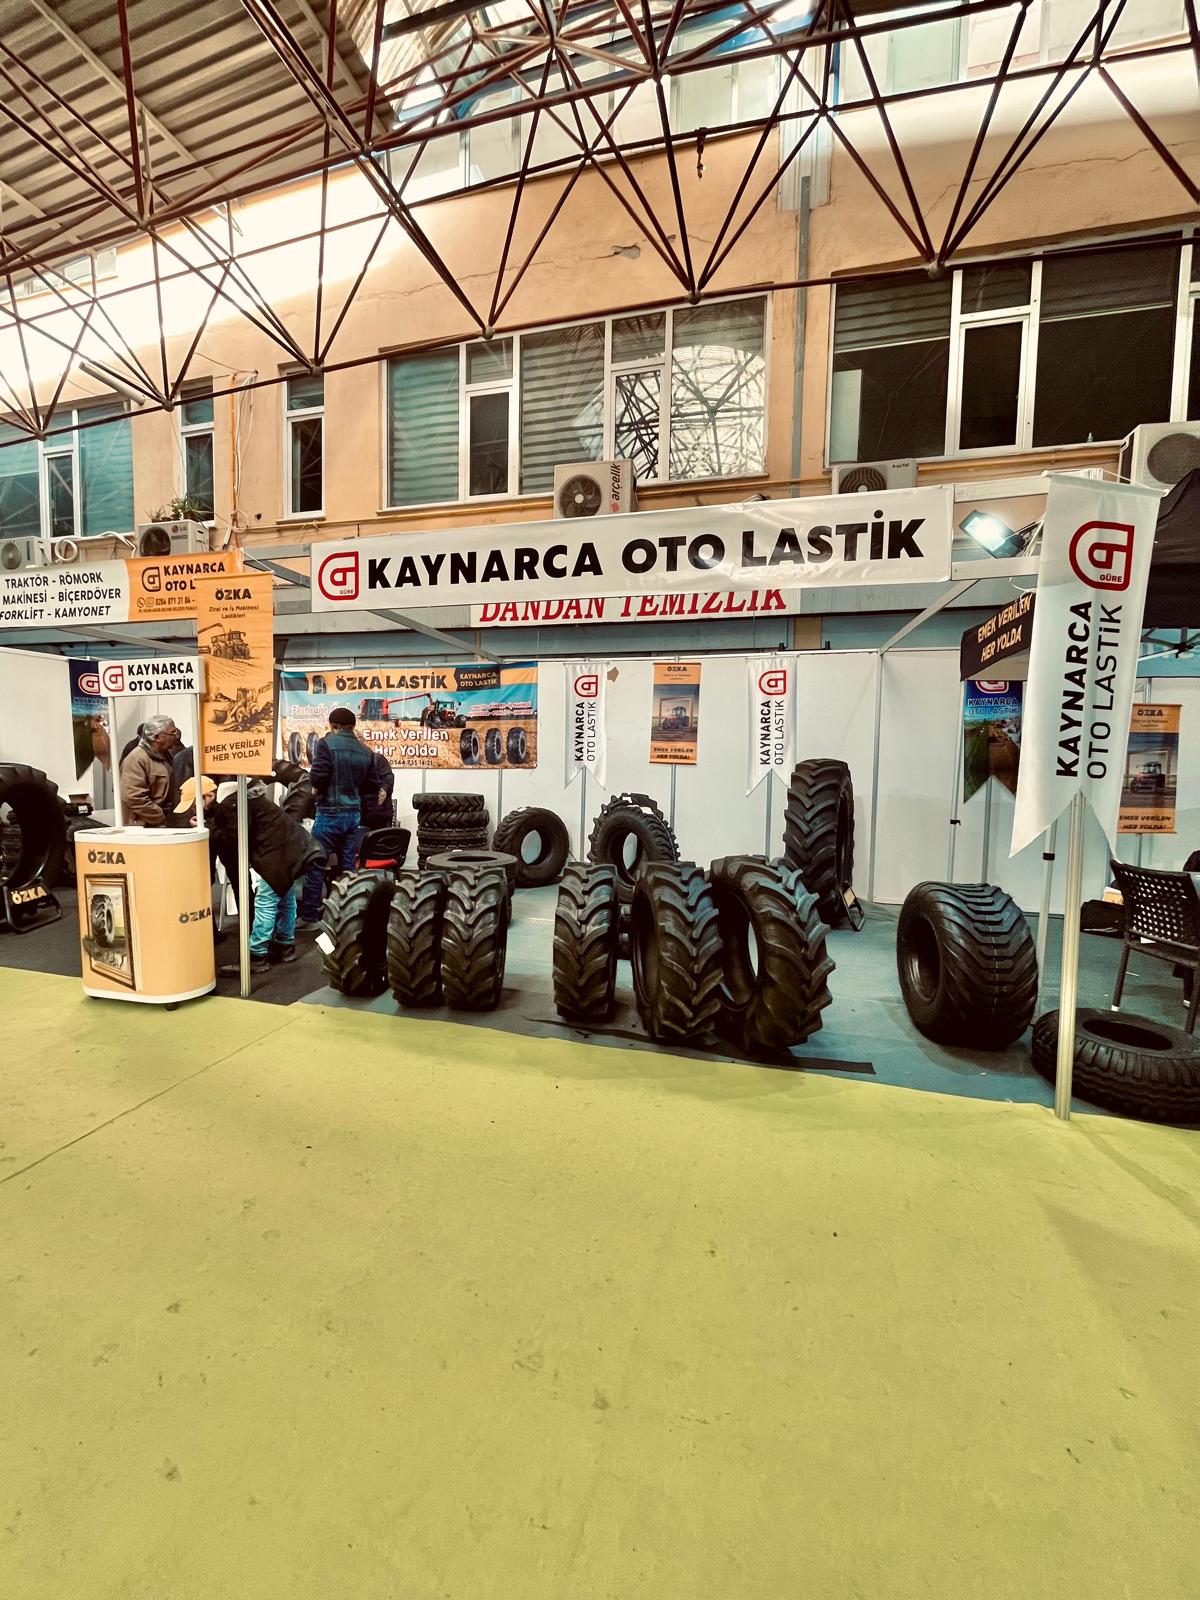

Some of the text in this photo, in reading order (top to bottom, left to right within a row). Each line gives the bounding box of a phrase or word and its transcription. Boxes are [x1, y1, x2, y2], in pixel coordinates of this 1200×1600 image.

[610, 463, 622, 501] arçelik
[367, 509, 926, 590] KAYNARCA OTO LASTİK
[163, 561, 225, 576] KAYNARCA
[5, 574, 49, 589] TRAKTÖR
[59, 571, 103, 585] RÖMORK
[164, 580, 187, 592] OTO
[1099, 574, 1123, 583] GÜRE
[2, 590, 48, 605] MAKİNESİ
[58, 587, 121, 604] BİÇERDÖVER
[215, 587, 252, 601] ÖZKA
[0, 607, 45, 620] FORKLİFT
[54, 605, 111, 618] KAMYONET
[977, 593, 1033, 644] EMEK VERİLEN
[980, 624, 1023, 662] HER YOLDA
[127, 662, 194, 676] KAYNARCA
[460, 671, 497, 679] KAYNARCA
[128, 675, 195, 692] OTO LASTİK
[335, 672, 448, 692] ÖZKA LASTİK
[1056, 601, 1092, 777] KAYNARCA
[1087, 604, 1123, 779] OTO LASTİK
[363, 726, 449, 741] Emek Verilen
[574, 701, 585, 762] KAYNARCA
[759, 699, 771, 765] KAYNARCA
[204, 739, 266, 754] EMEK VERİLEN
[400, 744, 438, 757] Yolda
[586, 741, 596, 762] OTO
[774, 743, 784, 765] OTO
[212, 750, 260, 762] HER YOLDA
[88, 849, 126, 865] ÖZKA
[12, 887, 47, 904] ÖZKA
[178, 907, 212, 924] ÖZKA
